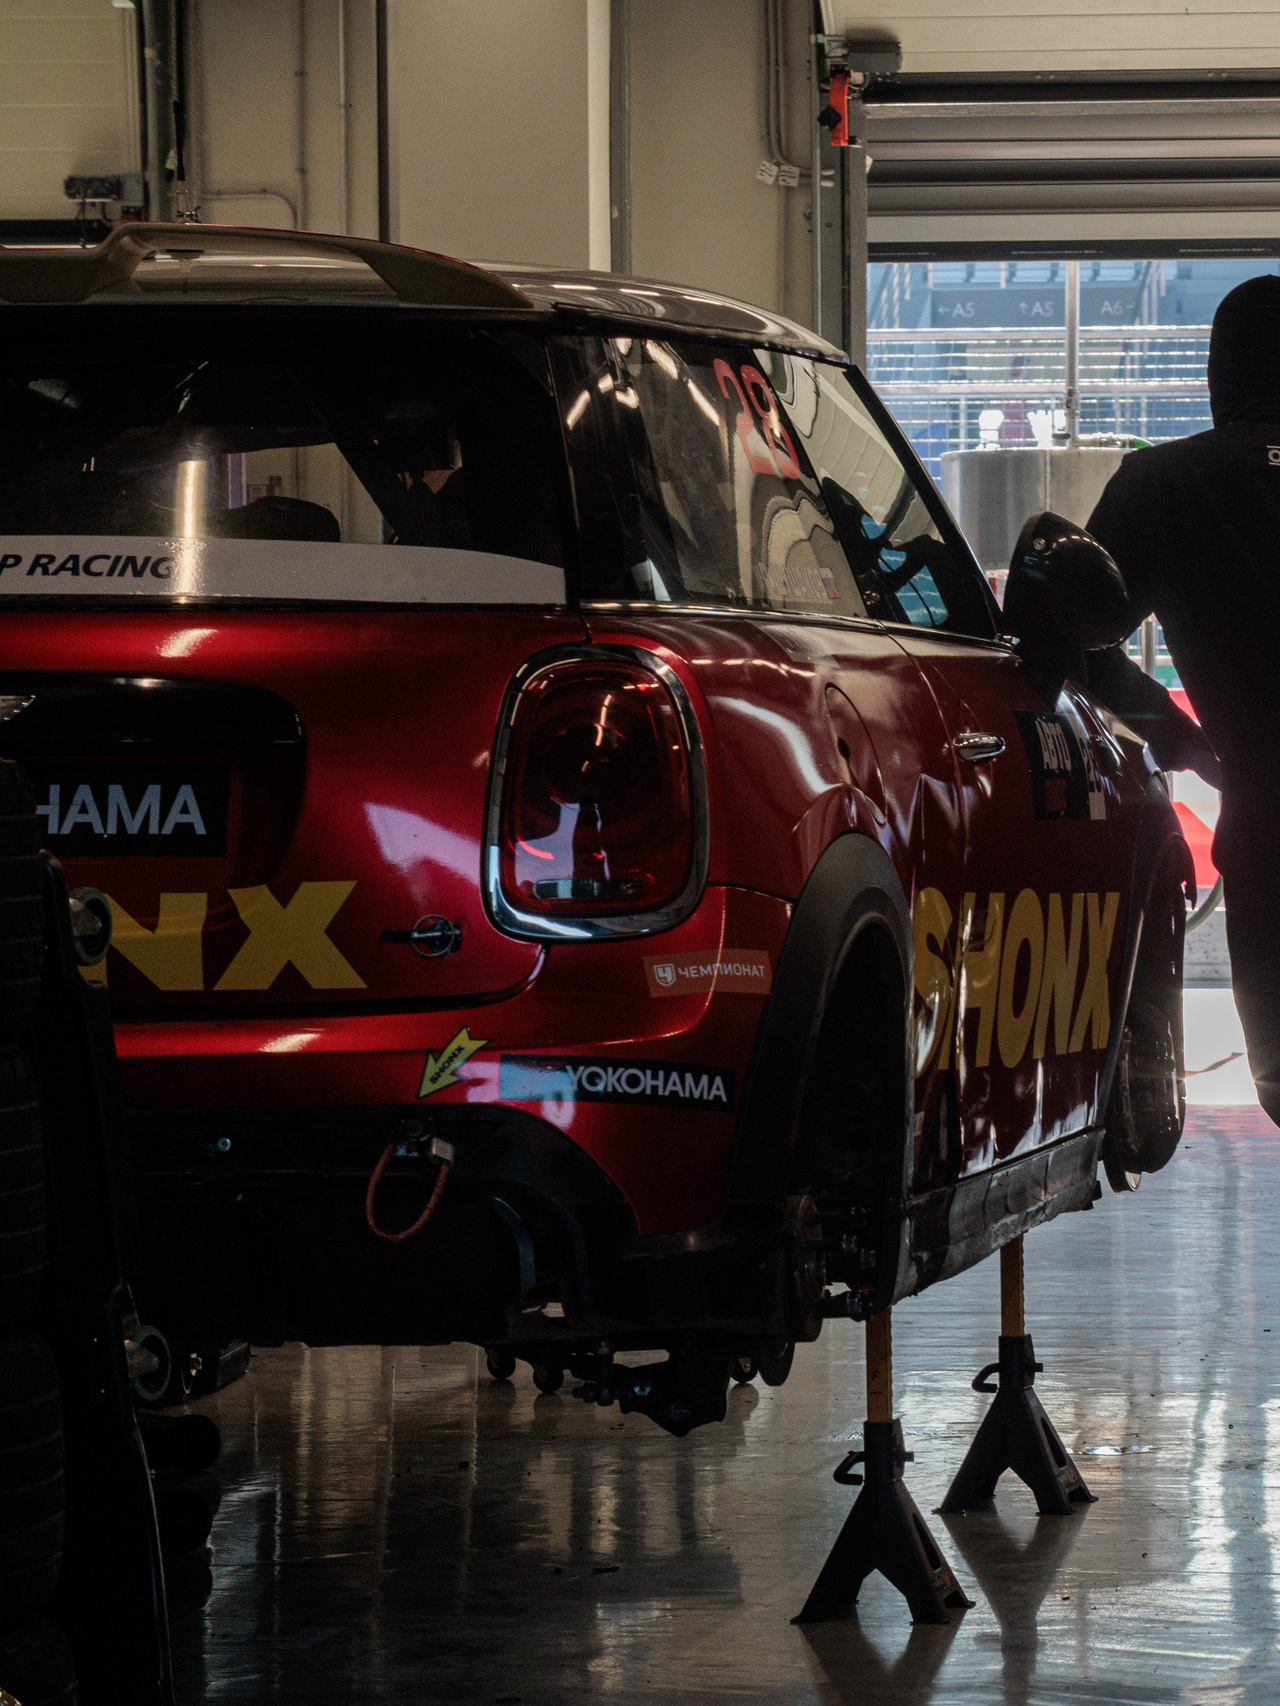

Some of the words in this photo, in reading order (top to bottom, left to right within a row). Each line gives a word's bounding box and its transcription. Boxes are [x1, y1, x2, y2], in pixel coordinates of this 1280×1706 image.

[713, 357, 801, 481] 28
[26, 554, 174, 579] RACING
[678, 963, 766, 979] ЧЕМПИОНАТ
[911, 887, 1120, 1080] SHONX
[429, 1045, 466, 1085] SHONX
[565, 1065, 728, 1103] YOKOHAMA
